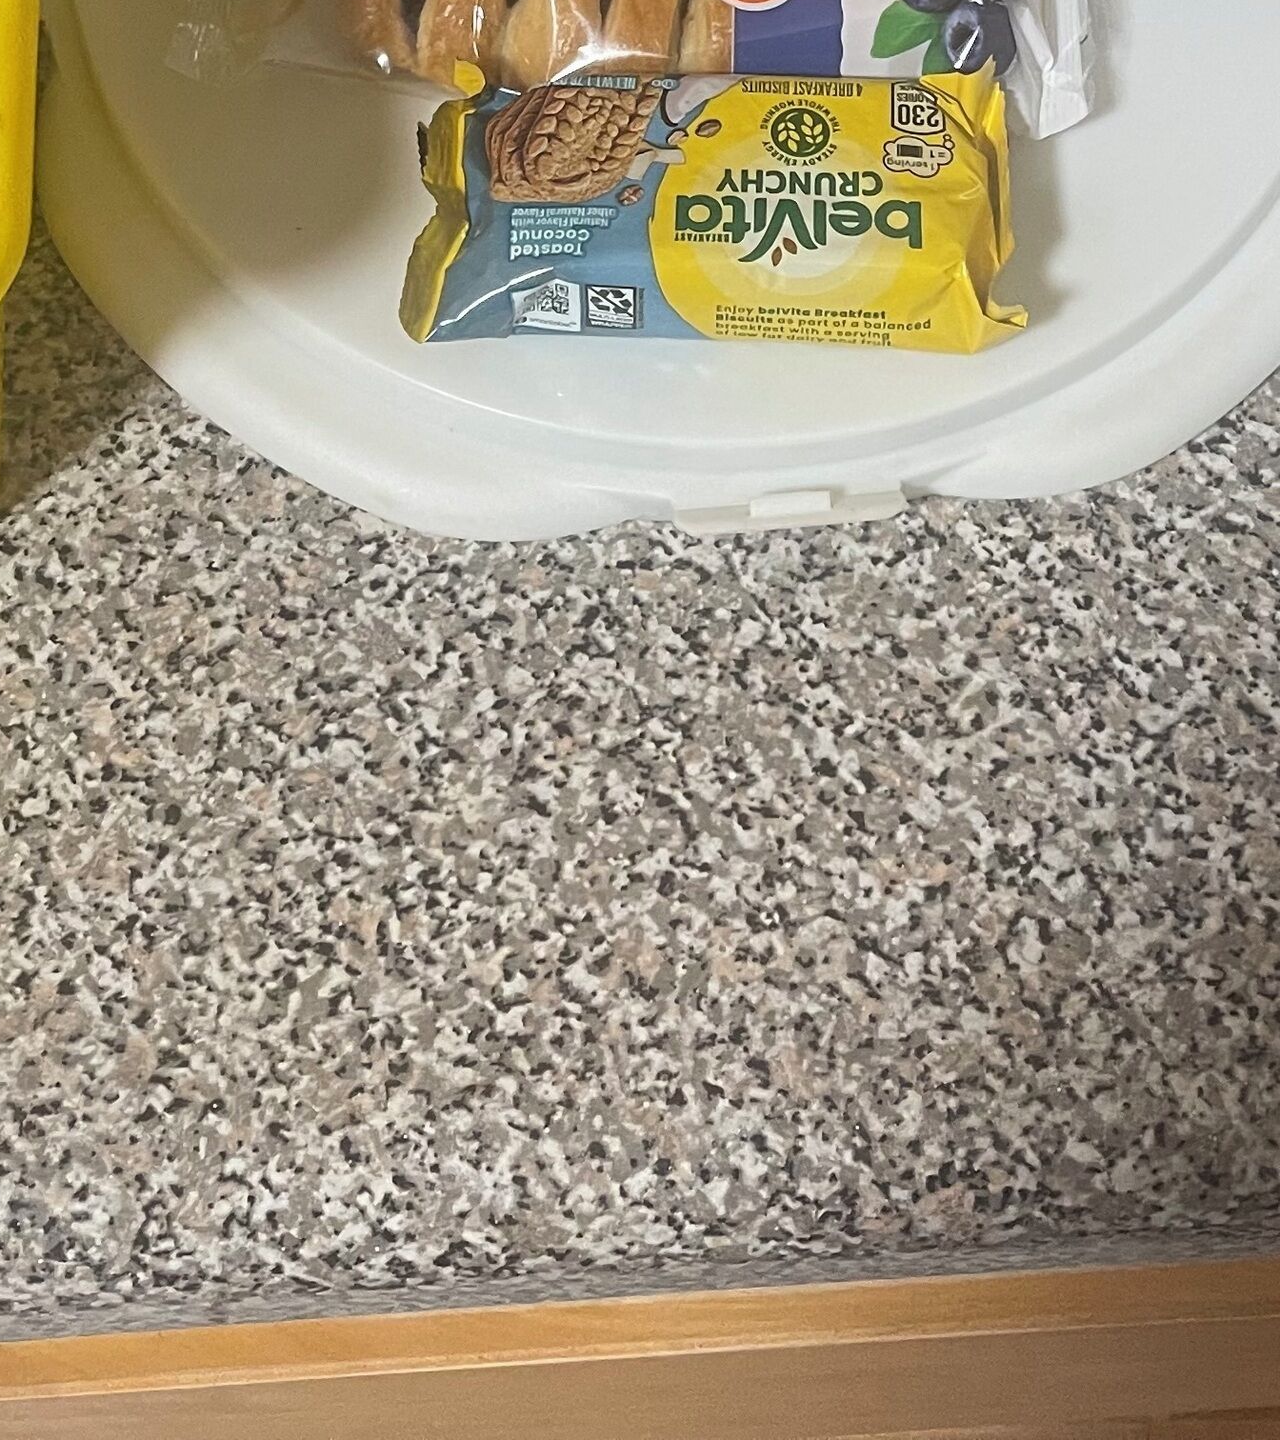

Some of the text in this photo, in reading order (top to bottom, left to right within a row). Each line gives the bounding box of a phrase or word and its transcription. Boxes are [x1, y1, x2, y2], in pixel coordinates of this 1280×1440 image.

[741, 79, 863, 97] 4 BREAKFAST BISCUITS
[760, 98, 841, 133] THE WHOLE MORNING
[897, 103, 940, 128] 230
[761, 139, 838, 167] STEADY ENERGY
[886, 156, 928, 168] serving
[715, 168, 884, 197] CRUNCHY
[512, 207, 546, 217] Flavor
[547, 207, 586, 218] Natural
[511, 216, 609, 227] Natural Flavor with
[675, 194, 923, 263] belVita
[510, 229, 590, 244] Coconut
[674, 231, 730, 243] BREAKFAST
[510, 243, 583, 261] Toasted
[716, 304, 886, 320] Enjoy belVita Breakfast
[715, 313, 773, 324] Biscuits
[777, 317, 794, 325] as
[798, 318, 828, 327] part
[832, 319, 847, 328] of
[864, 318, 932, 331] balanced
[715, 322, 785, 333] breakfast
[789, 326, 819, 335] with
[836, 330, 891, 340] serving
